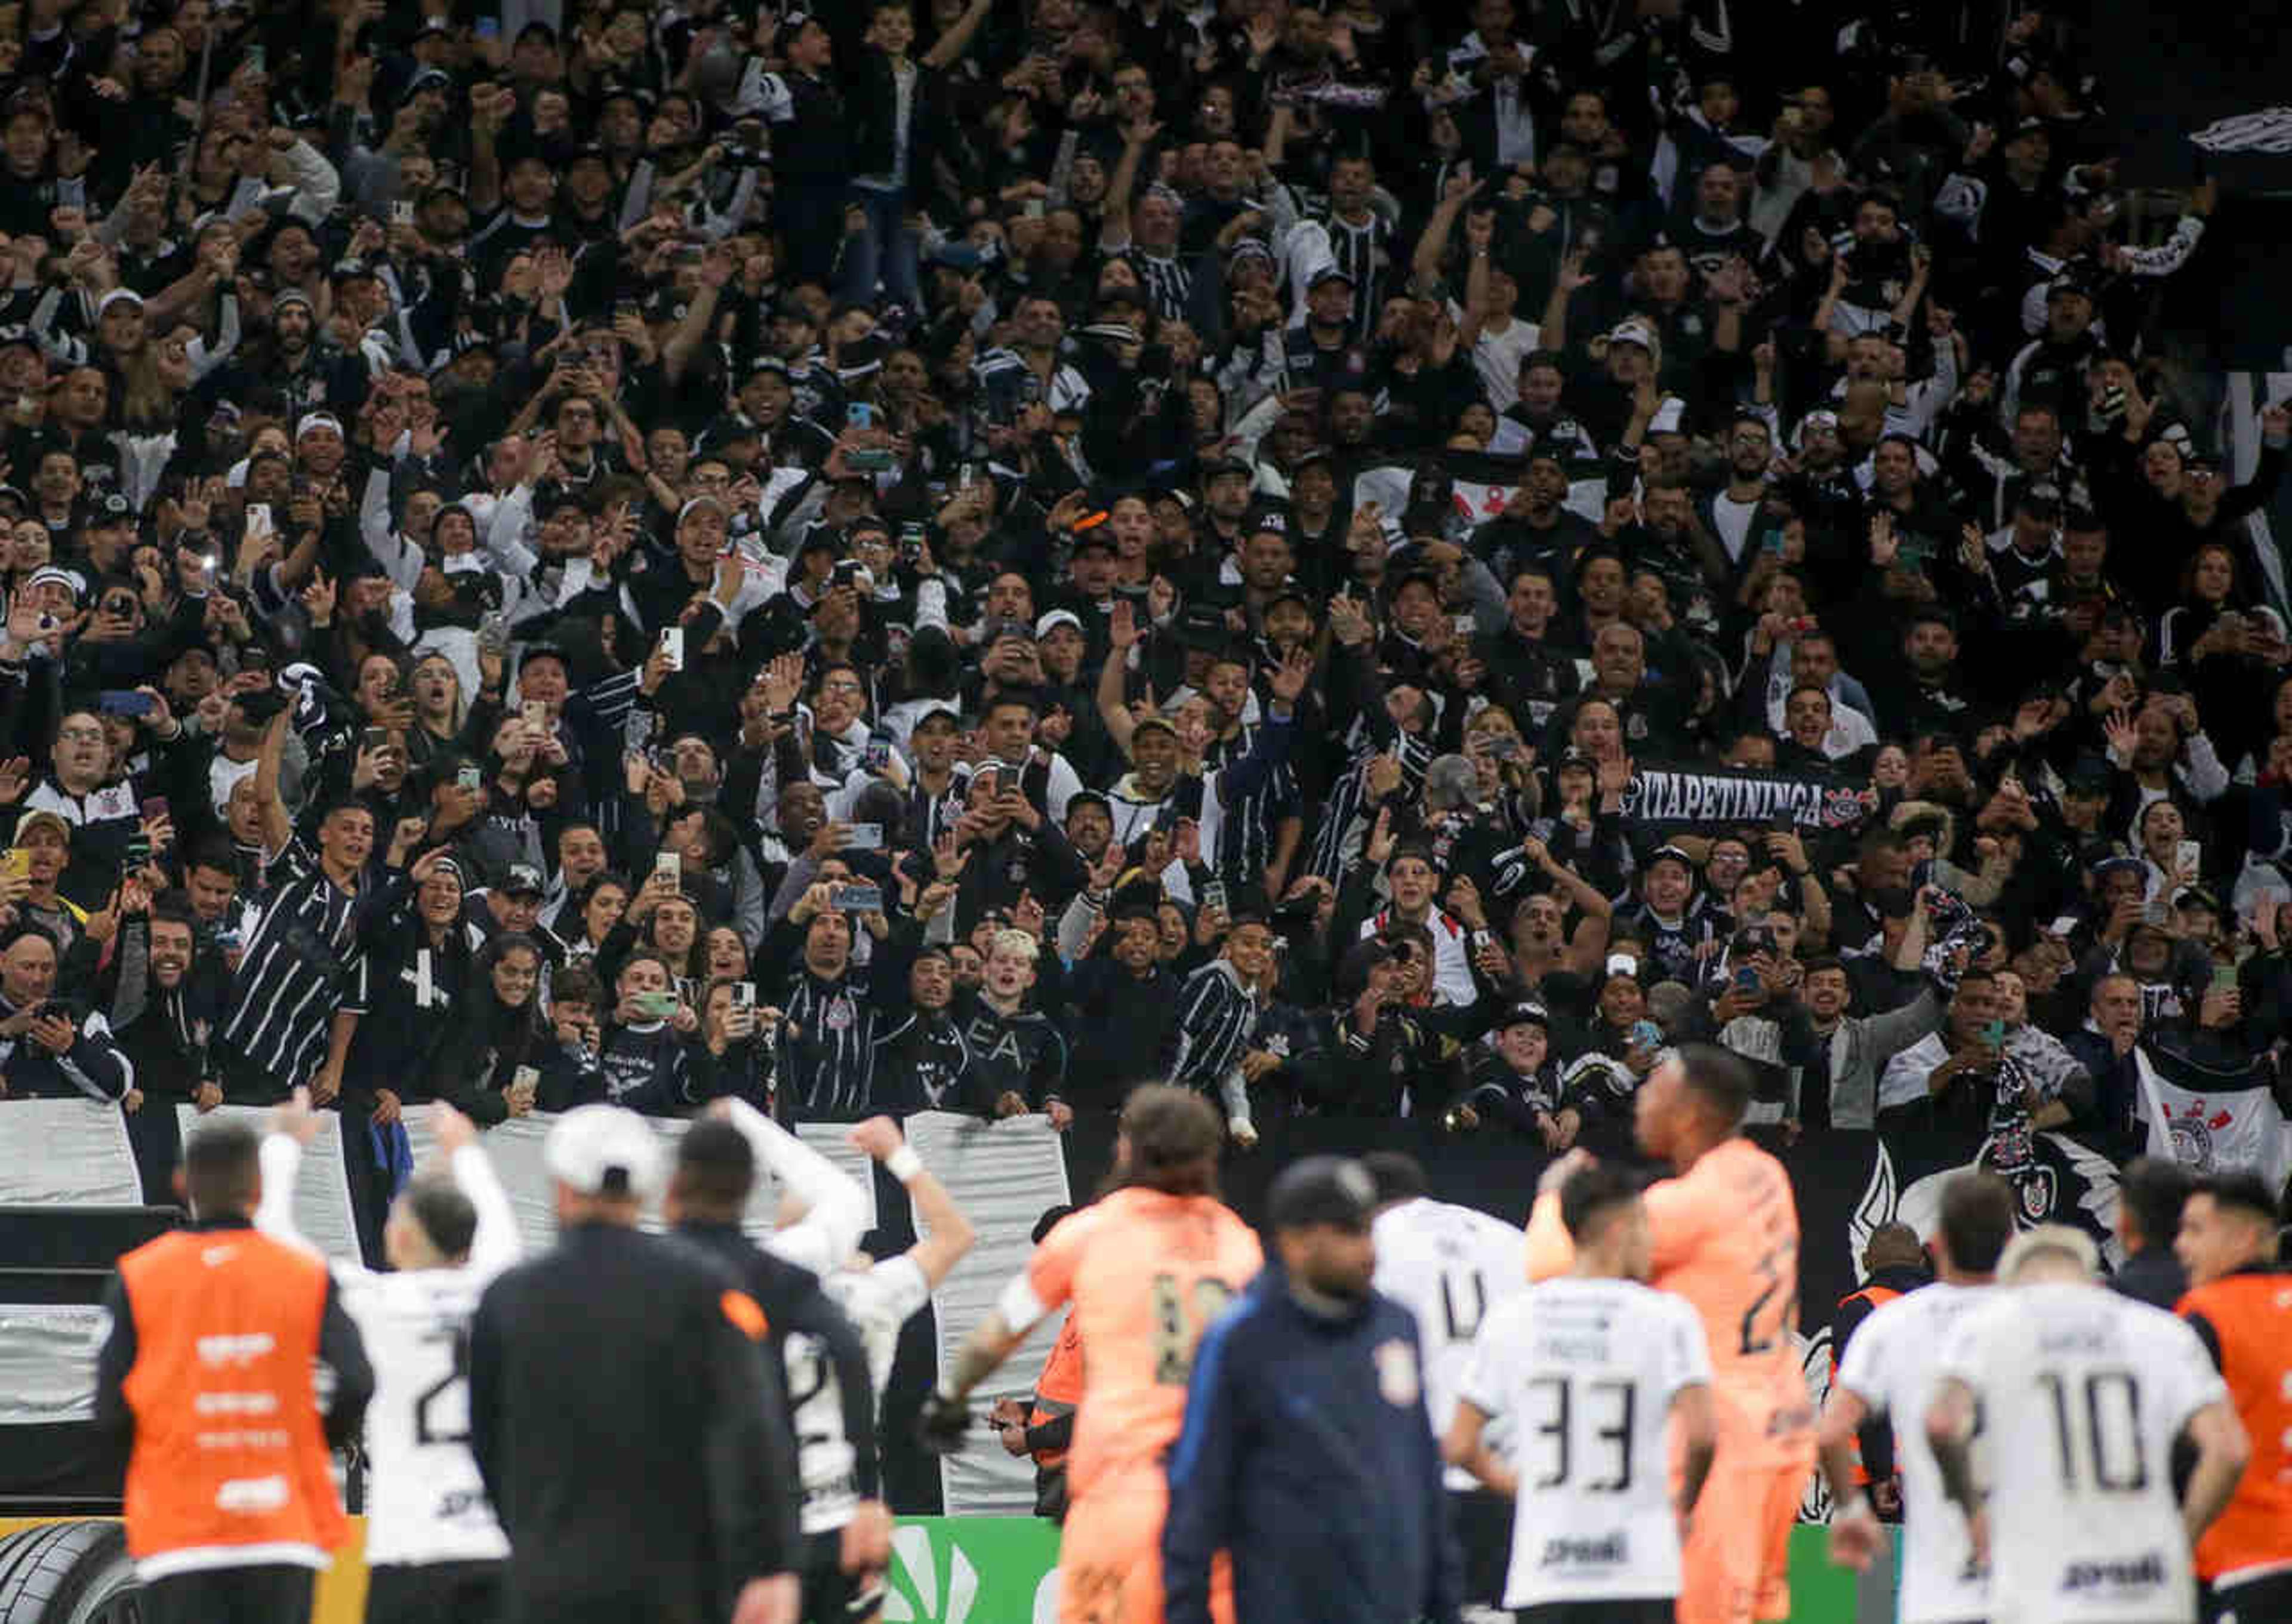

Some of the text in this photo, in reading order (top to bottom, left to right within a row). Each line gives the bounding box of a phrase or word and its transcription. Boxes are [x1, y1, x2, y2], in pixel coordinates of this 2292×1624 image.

[1641, 771, 1822, 827] ITAPETININGA
[1527, 1376, 1634, 1493] 33
[2035, 1370, 2148, 1493] 10
